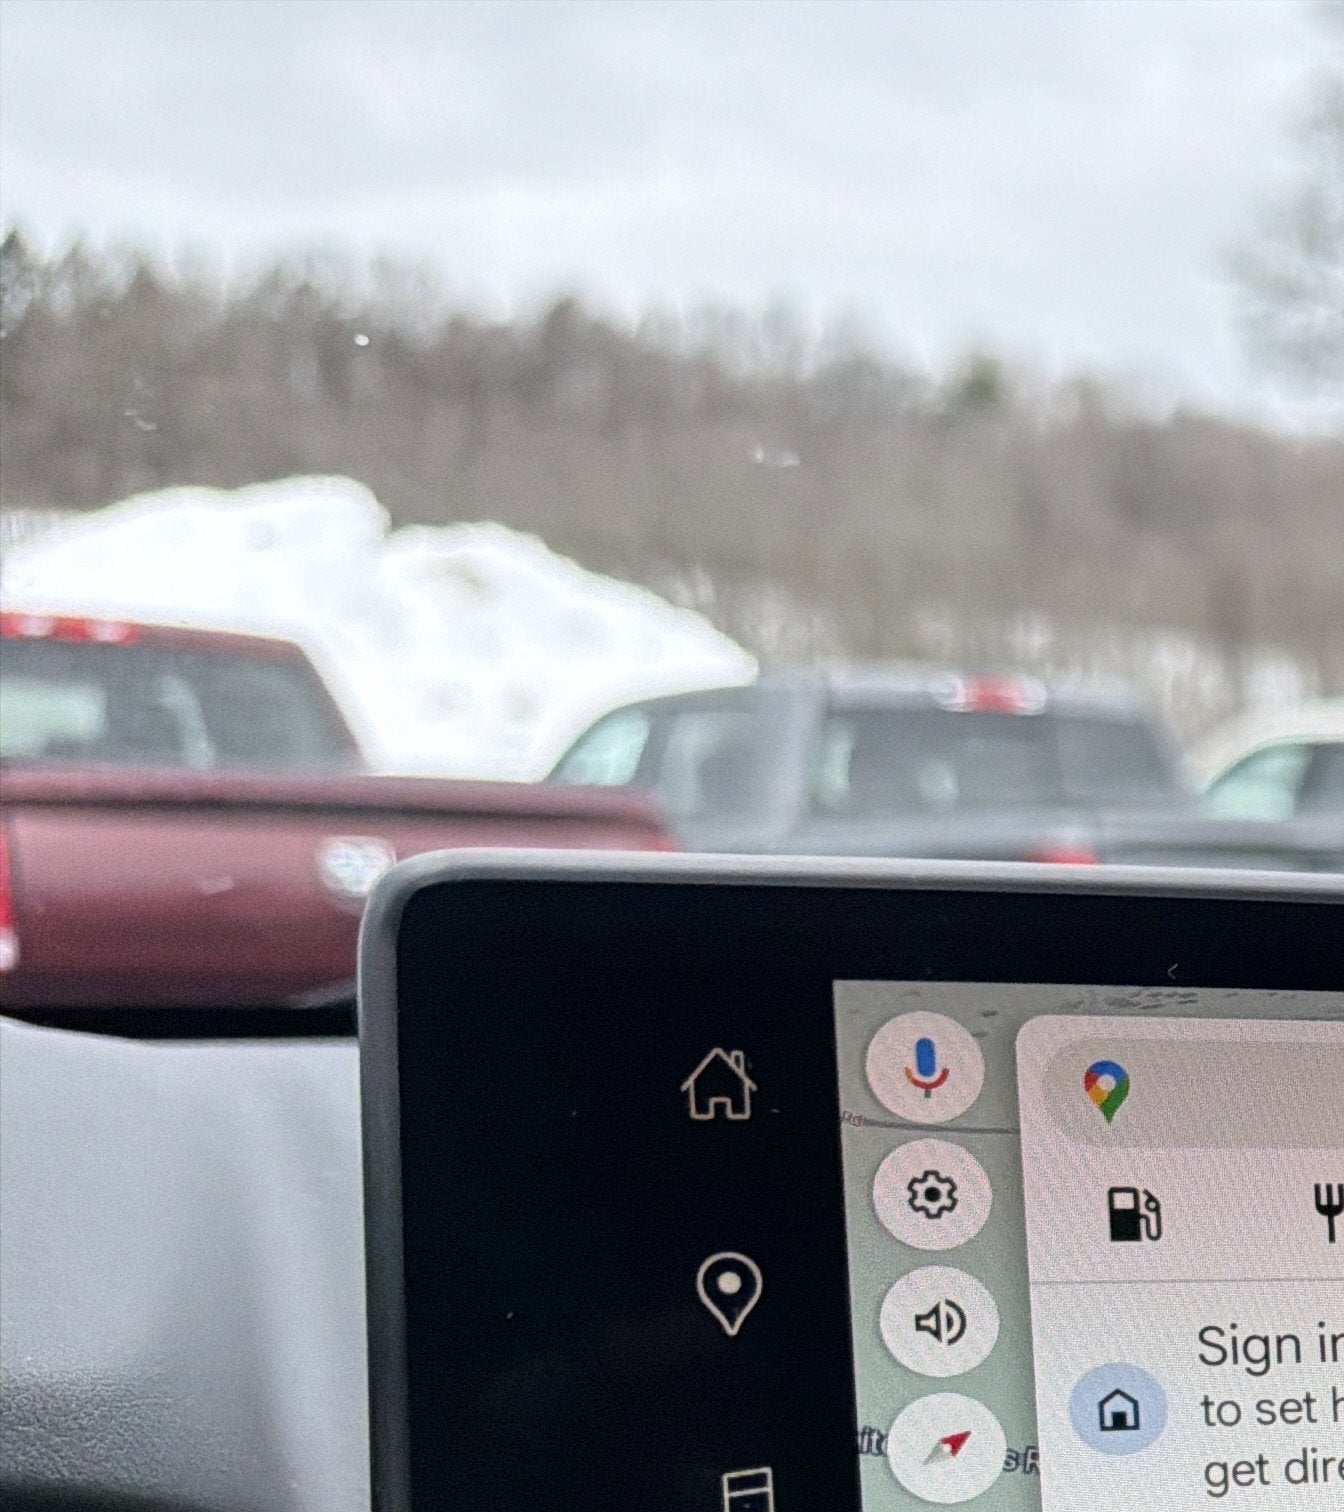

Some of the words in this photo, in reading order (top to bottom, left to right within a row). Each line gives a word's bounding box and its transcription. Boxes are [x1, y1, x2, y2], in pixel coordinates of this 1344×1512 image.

[1198, 1323, 1302, 1377] Sign
[1200, 1394, 1242, 1427] to
[1255, 1391, 1318, 1425] set
[1204, 1453, 1271, 1498] get
